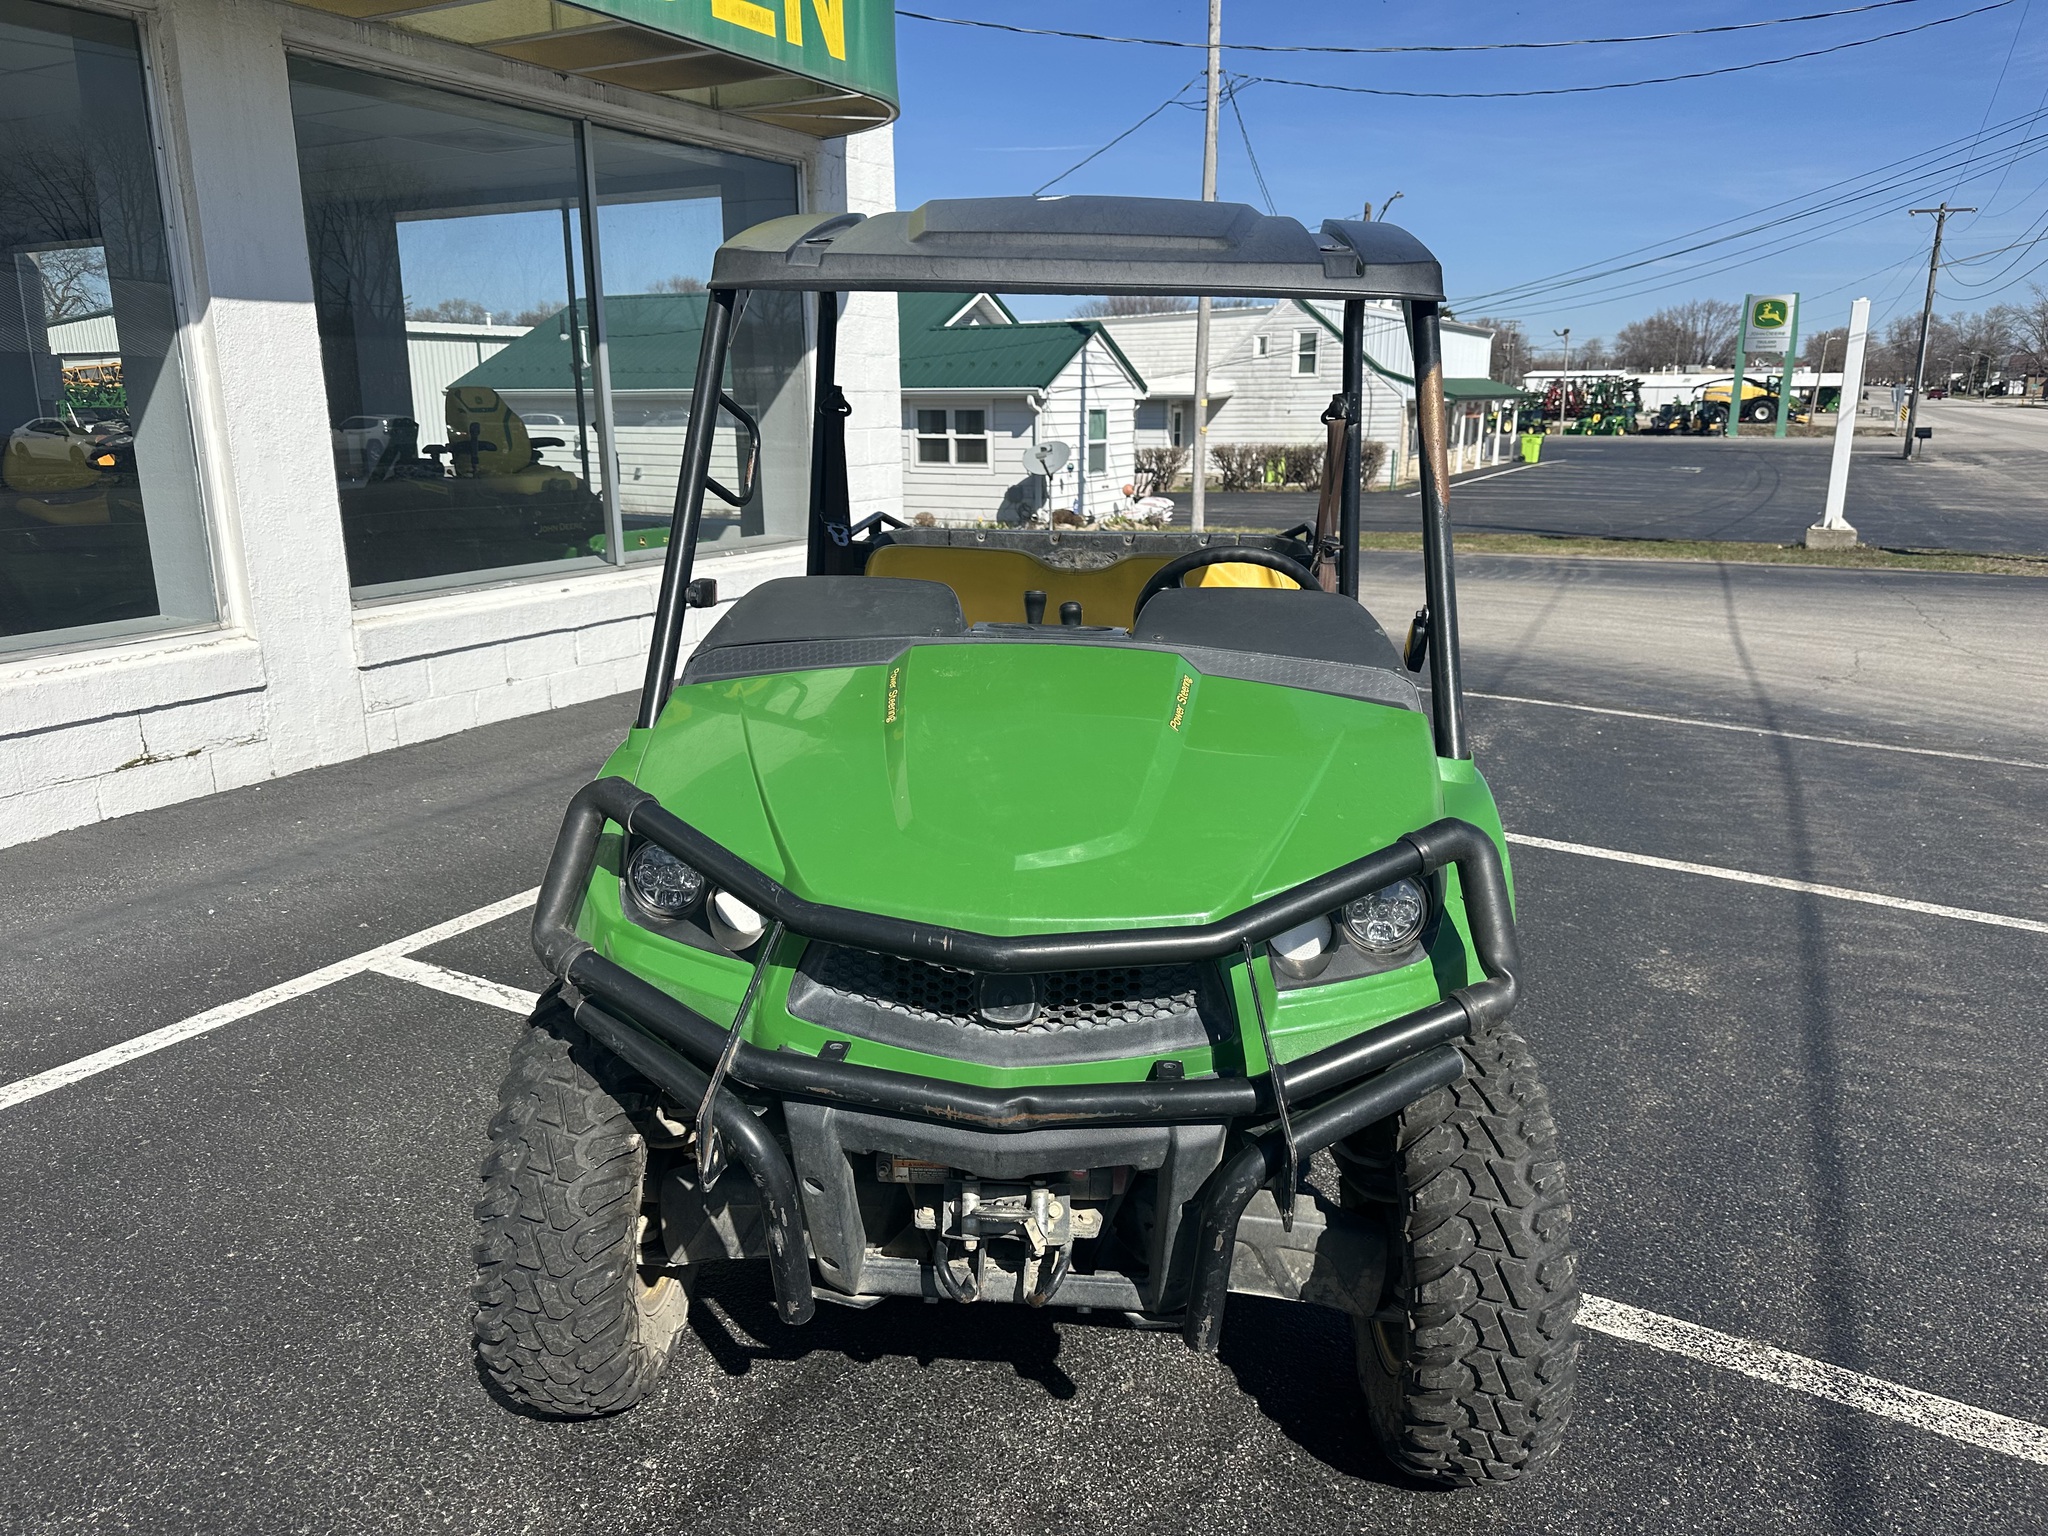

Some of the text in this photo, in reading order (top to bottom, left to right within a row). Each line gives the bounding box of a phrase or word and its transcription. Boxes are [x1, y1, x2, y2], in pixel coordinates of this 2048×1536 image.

[538, 522, 584, 533] JOHN DEERE
[1169, 674, 1194, 732] Power Steering
